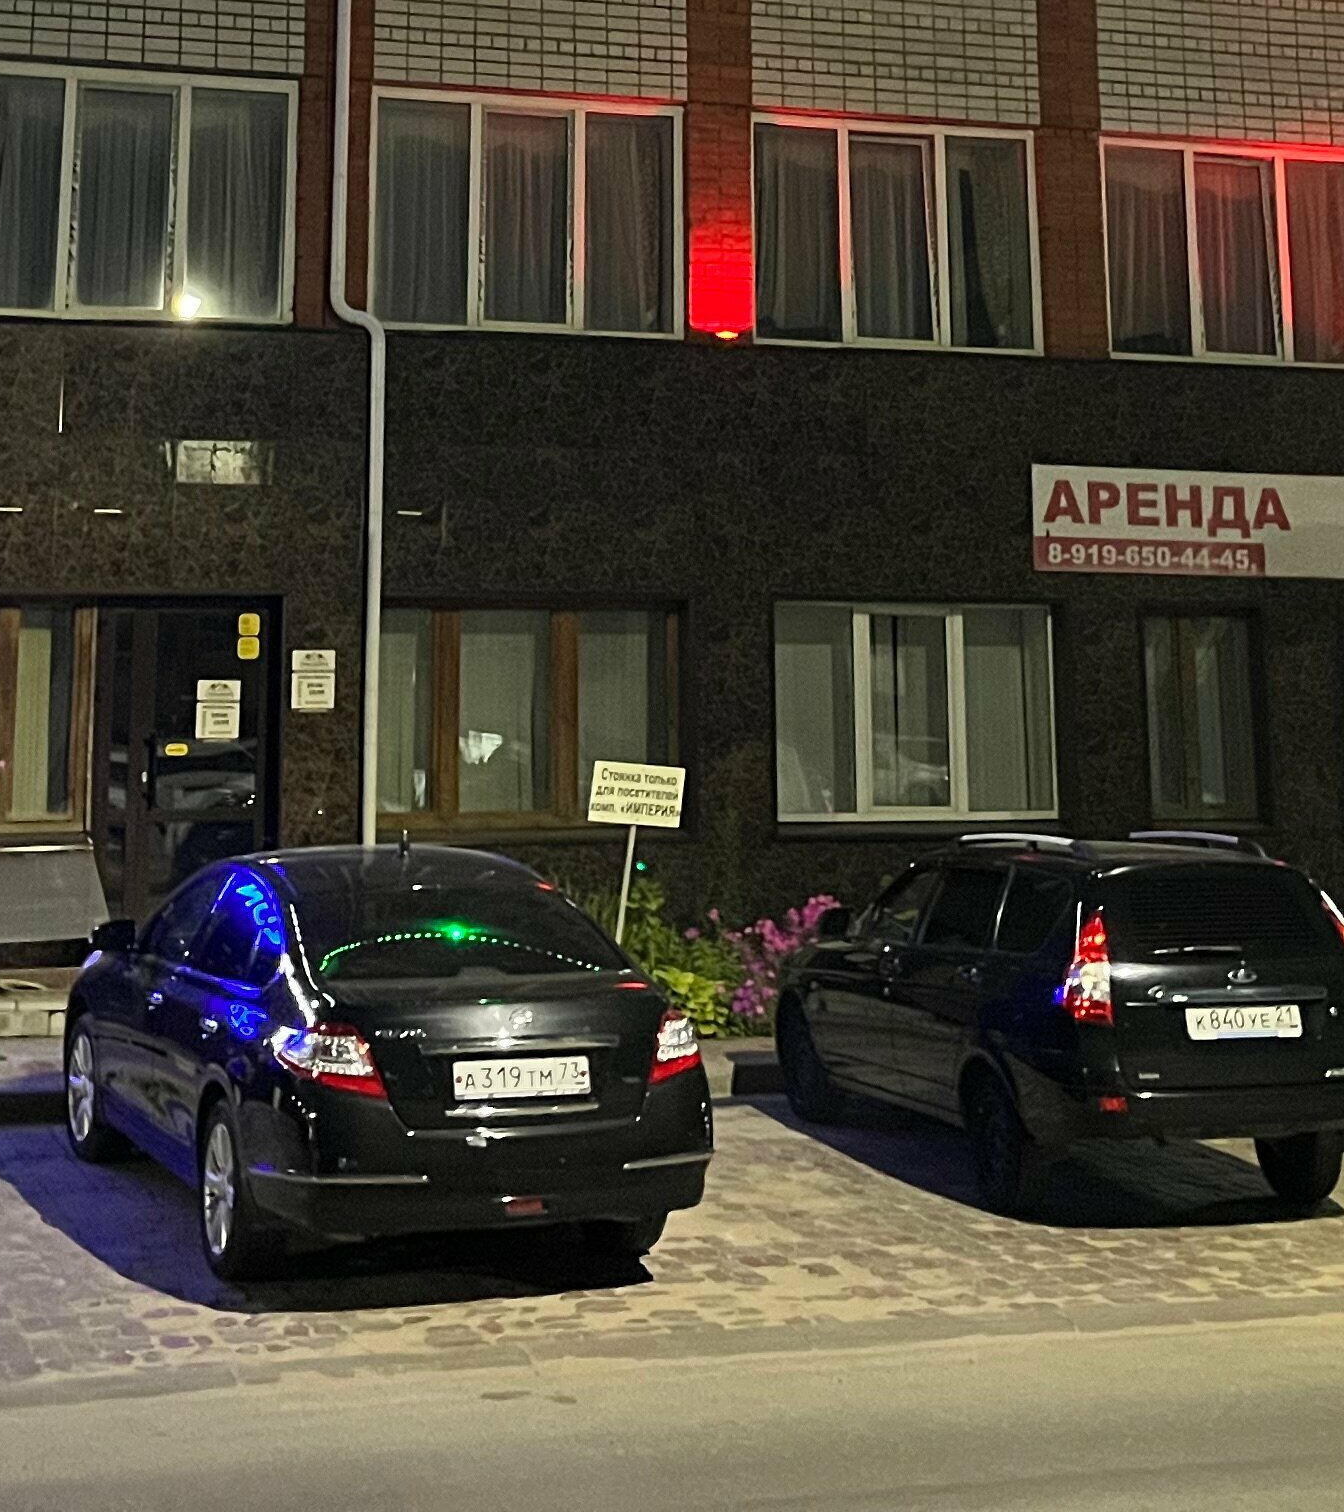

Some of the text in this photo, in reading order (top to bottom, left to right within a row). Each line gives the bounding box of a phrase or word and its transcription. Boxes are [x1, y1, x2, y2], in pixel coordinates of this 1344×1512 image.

[1043, 479, 1291, 538] АРЕНДА
[601, 767, 678, 786] Стоянка только
[596, 785, 679, 800] для посетителей
